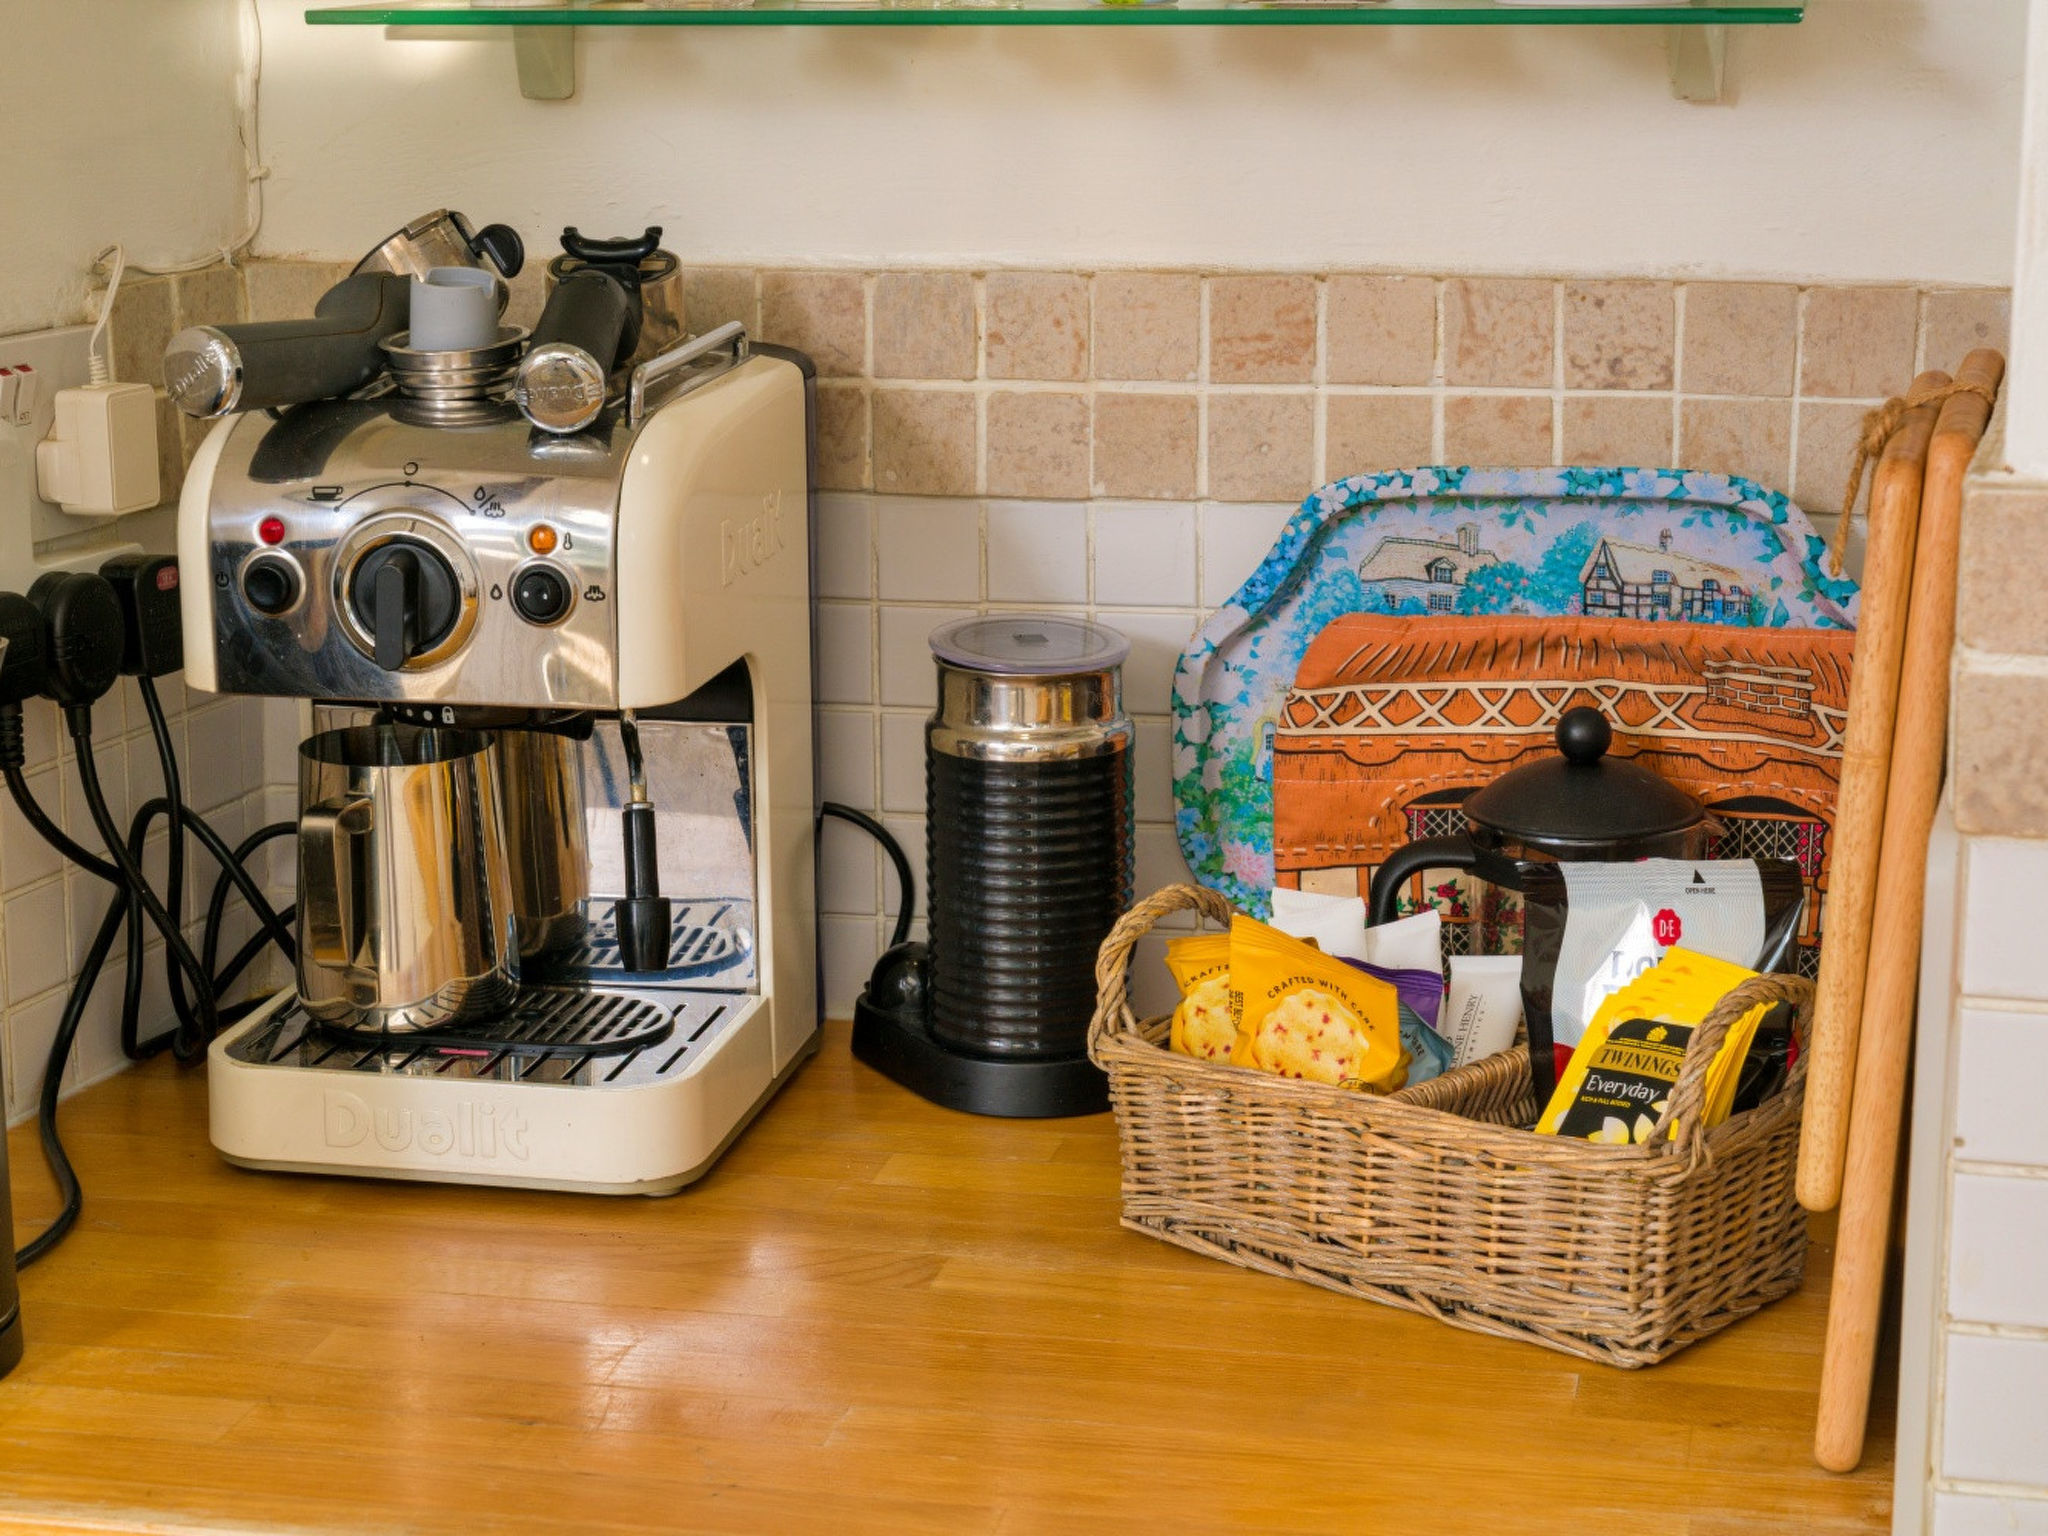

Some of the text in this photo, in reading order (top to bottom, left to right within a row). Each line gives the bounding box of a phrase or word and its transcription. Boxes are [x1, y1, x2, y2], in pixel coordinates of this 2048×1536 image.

[1184, 963, 1230, 988] CRAFTE
[1267, 976, 1314, 999] CRAFTED
[1319, 979, 1348, 1001] WITH
[1600, 1048, 1682, 1077] TWININGS
[1586, 1074, 1660, 1104] Everyday
[323, 1088, 529, 1160] Dualit
